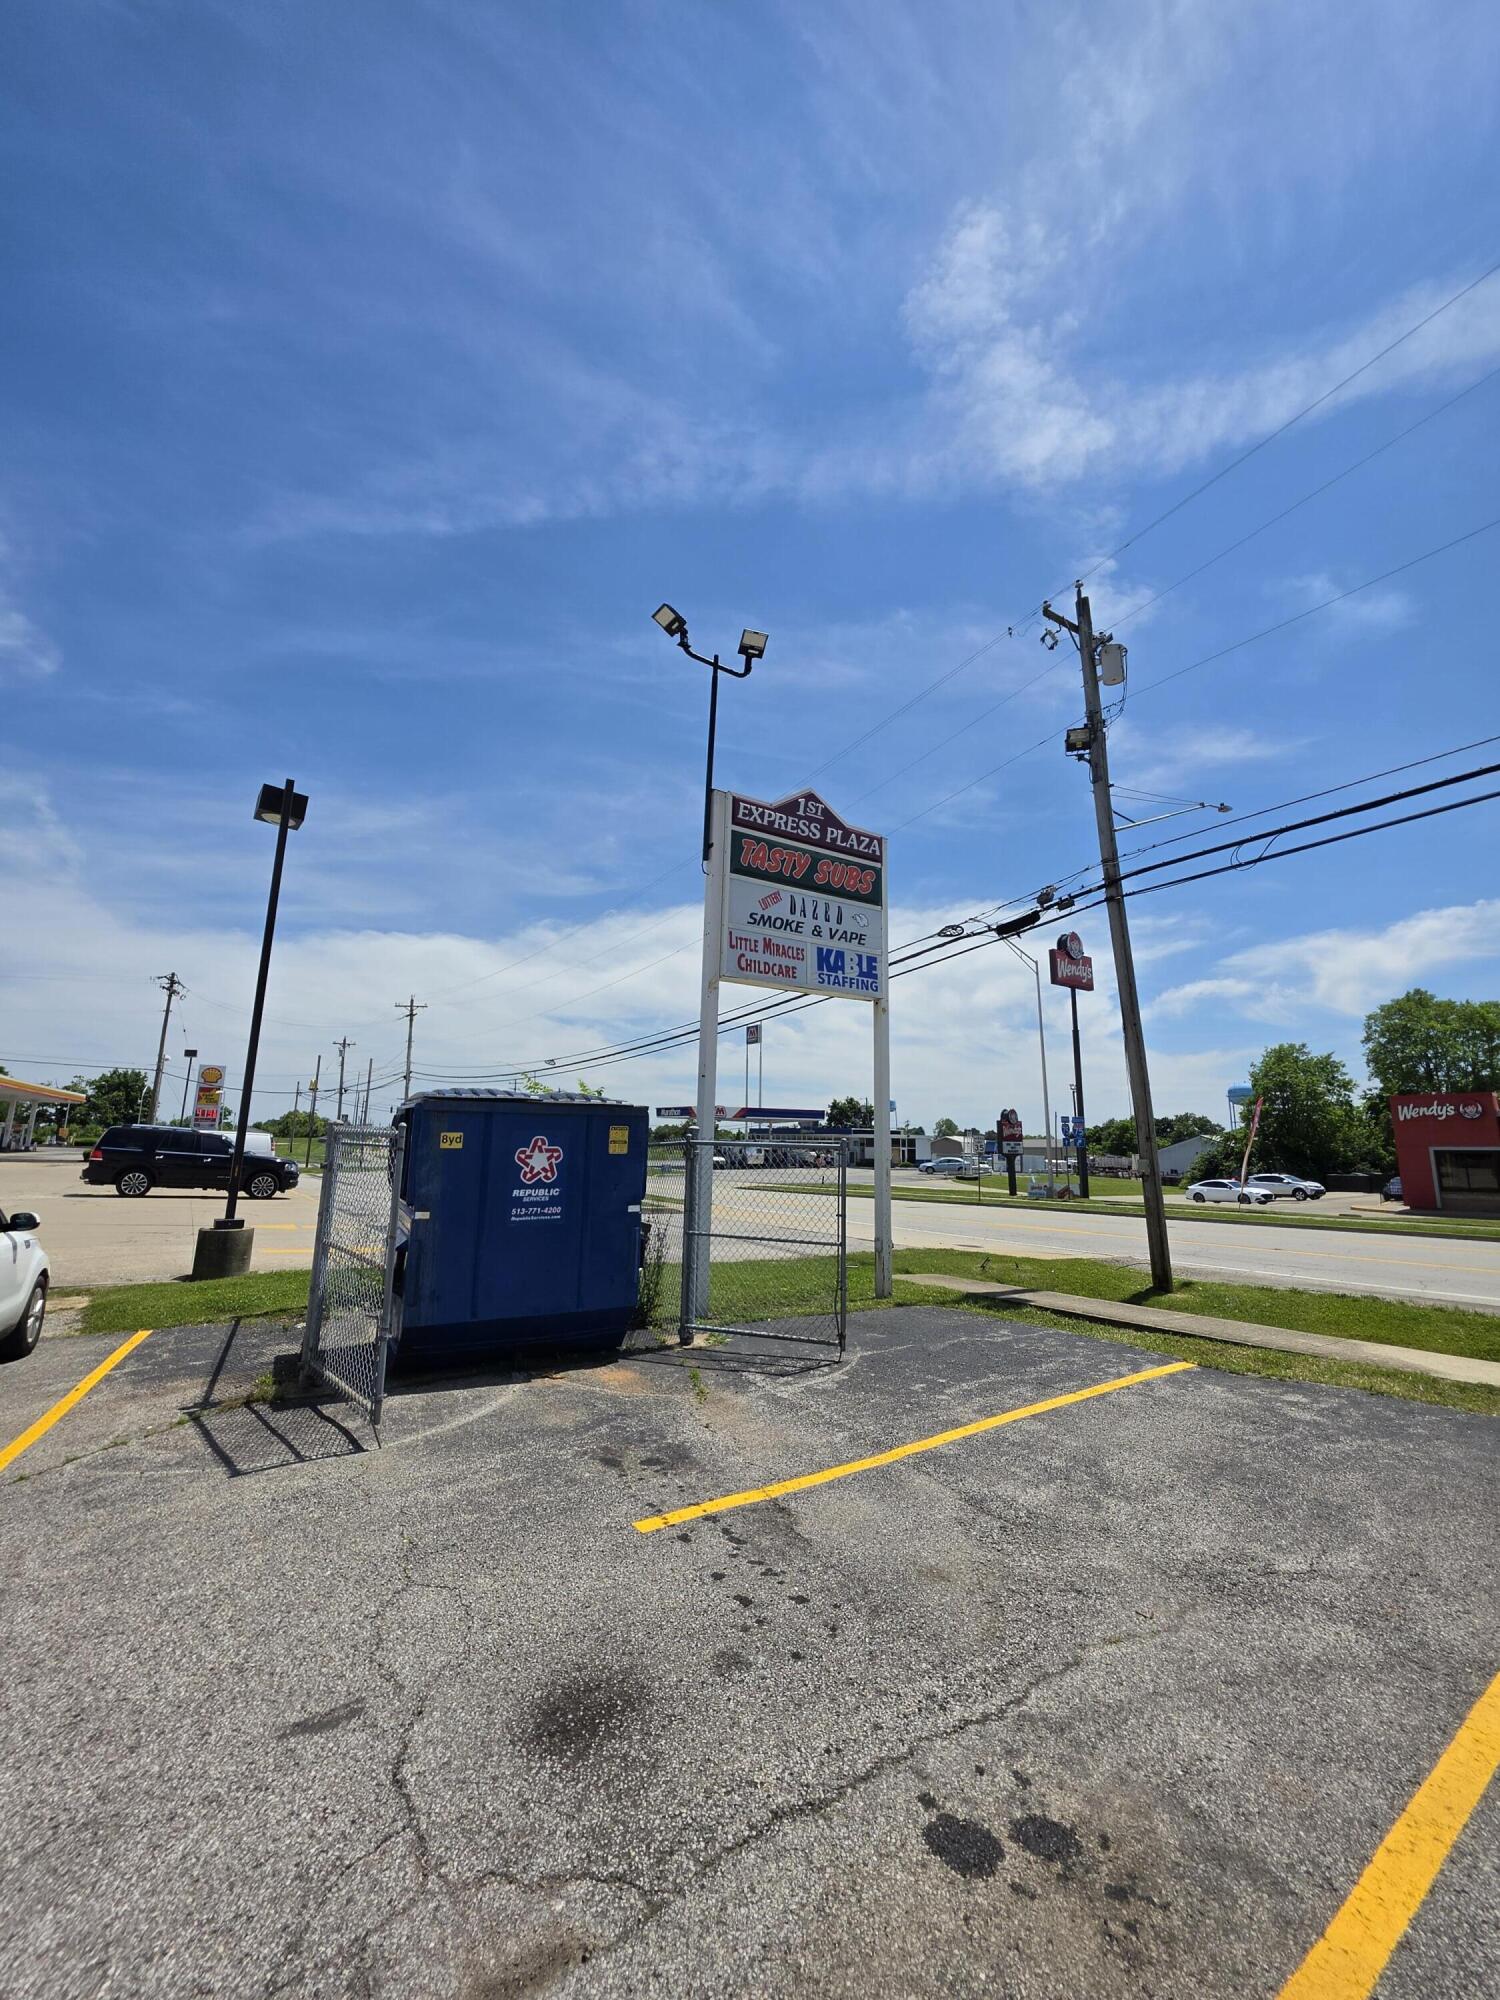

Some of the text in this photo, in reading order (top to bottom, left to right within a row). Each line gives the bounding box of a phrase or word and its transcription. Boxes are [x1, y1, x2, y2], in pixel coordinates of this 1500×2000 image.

[796, 798, 824, 819] 1ST
[738, 803, 880, 855] EXPRESS PLAZA
[741, 839, 875, 894] TASTY SUBS
[759, 890, 782, 910] LOTTERY
[789, 895, 842, 924] DAZED
[747, 912, 867, 946] SMOKE & VAPE
[729, 931, 805, 962] LITTLE MIRACLES
[737, 953, 797, 979] CHILDCARE
[817, 947, 878, 979] KABLE
[1057, 958, 1092, 982] Wendy's
[818, 974, 878, 992] STAFFING
[1398, 1100, 1455, 1120] Wendy's
[441, 1134, 463, 1146] 8yd
[974, 1144, 984, 1152] 35
[512, 1188, 560, 1197] REPUBLIC
[511, 1206, 562, 1215] 513-771-4200
